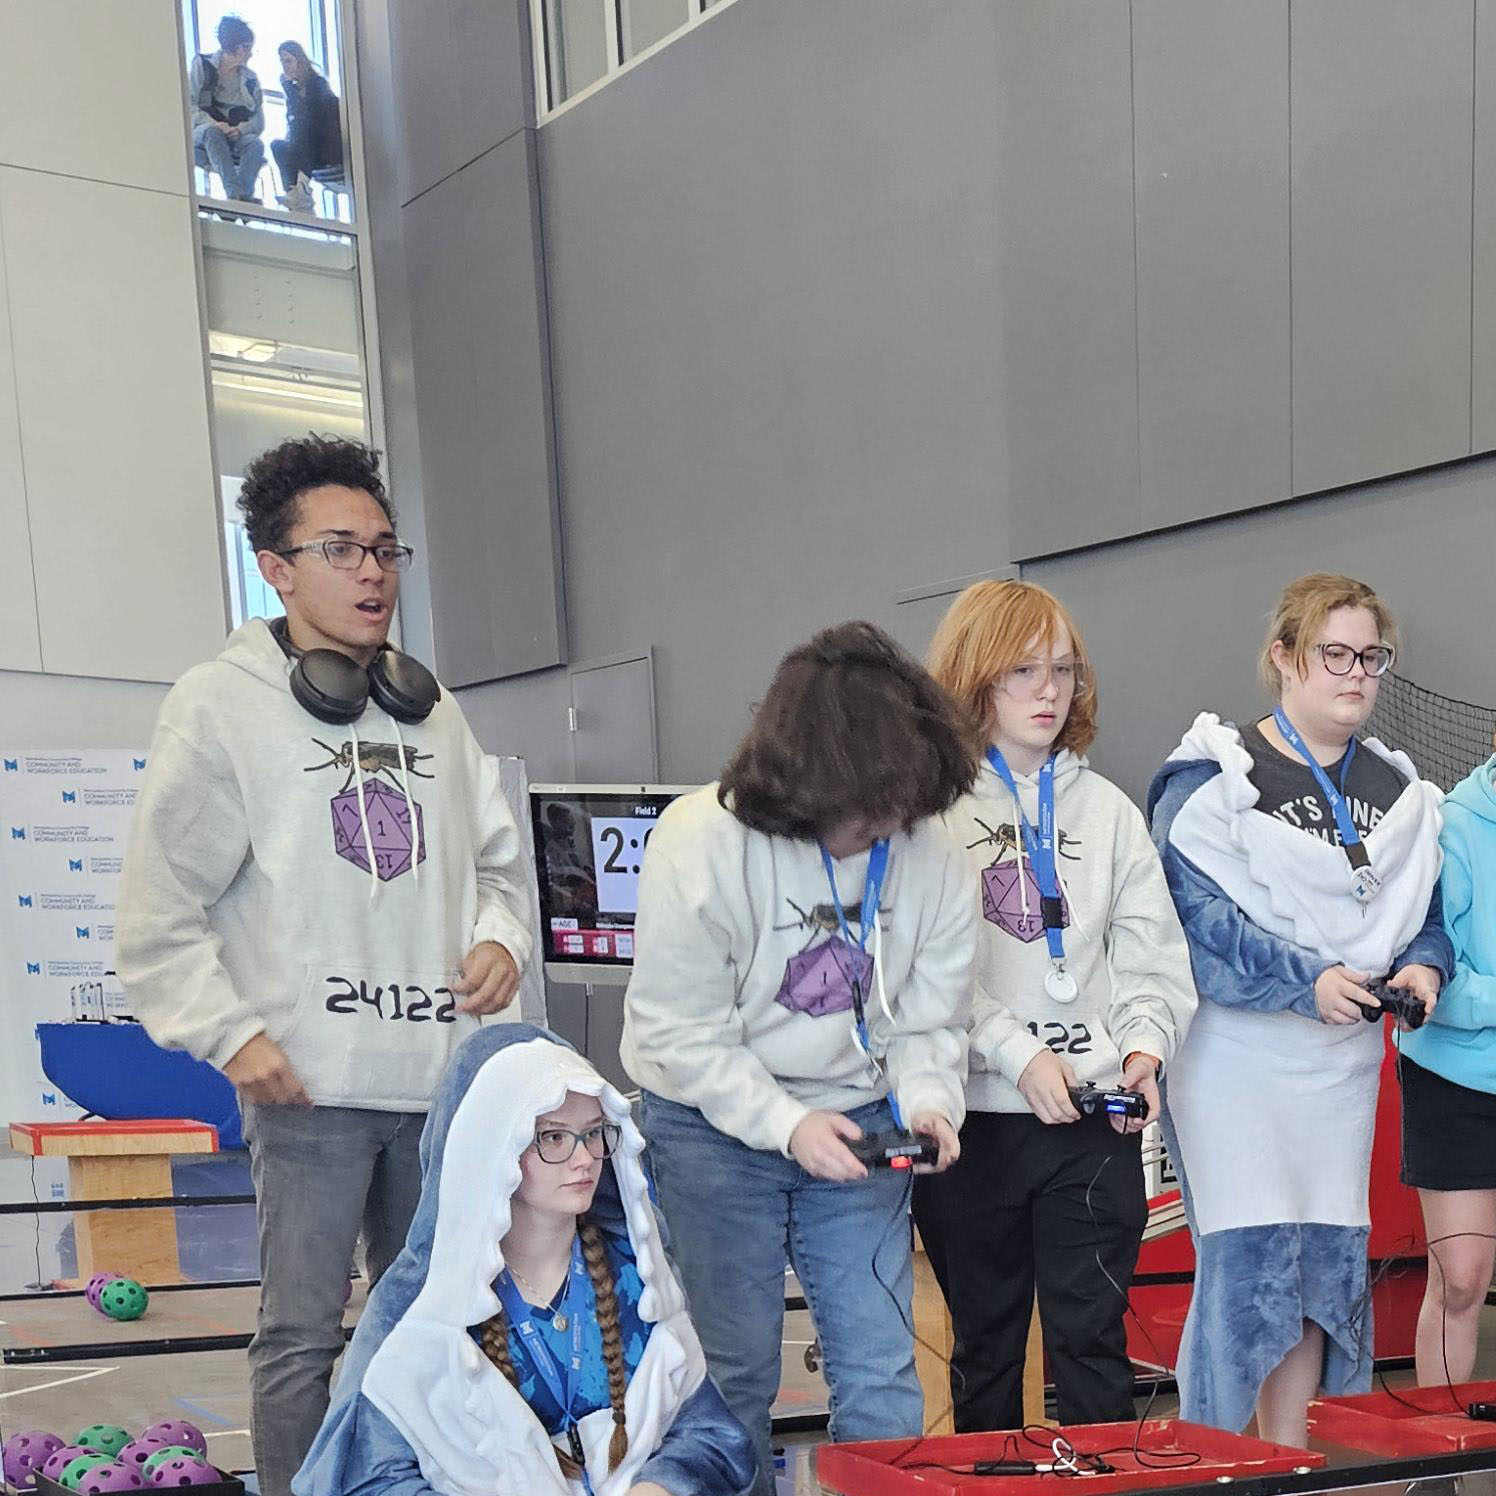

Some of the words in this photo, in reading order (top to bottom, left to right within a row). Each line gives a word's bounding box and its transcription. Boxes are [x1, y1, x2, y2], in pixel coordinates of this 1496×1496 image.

[635, 806, 652, 815] Field
[652, 806, 657, 815] 2
[1333, 796, 1384, 829] INE
[378, 820, 386, 836] 1
[326, 976, 457, 1023] 24122
[1027, 1021, 1093, 1054] 122
